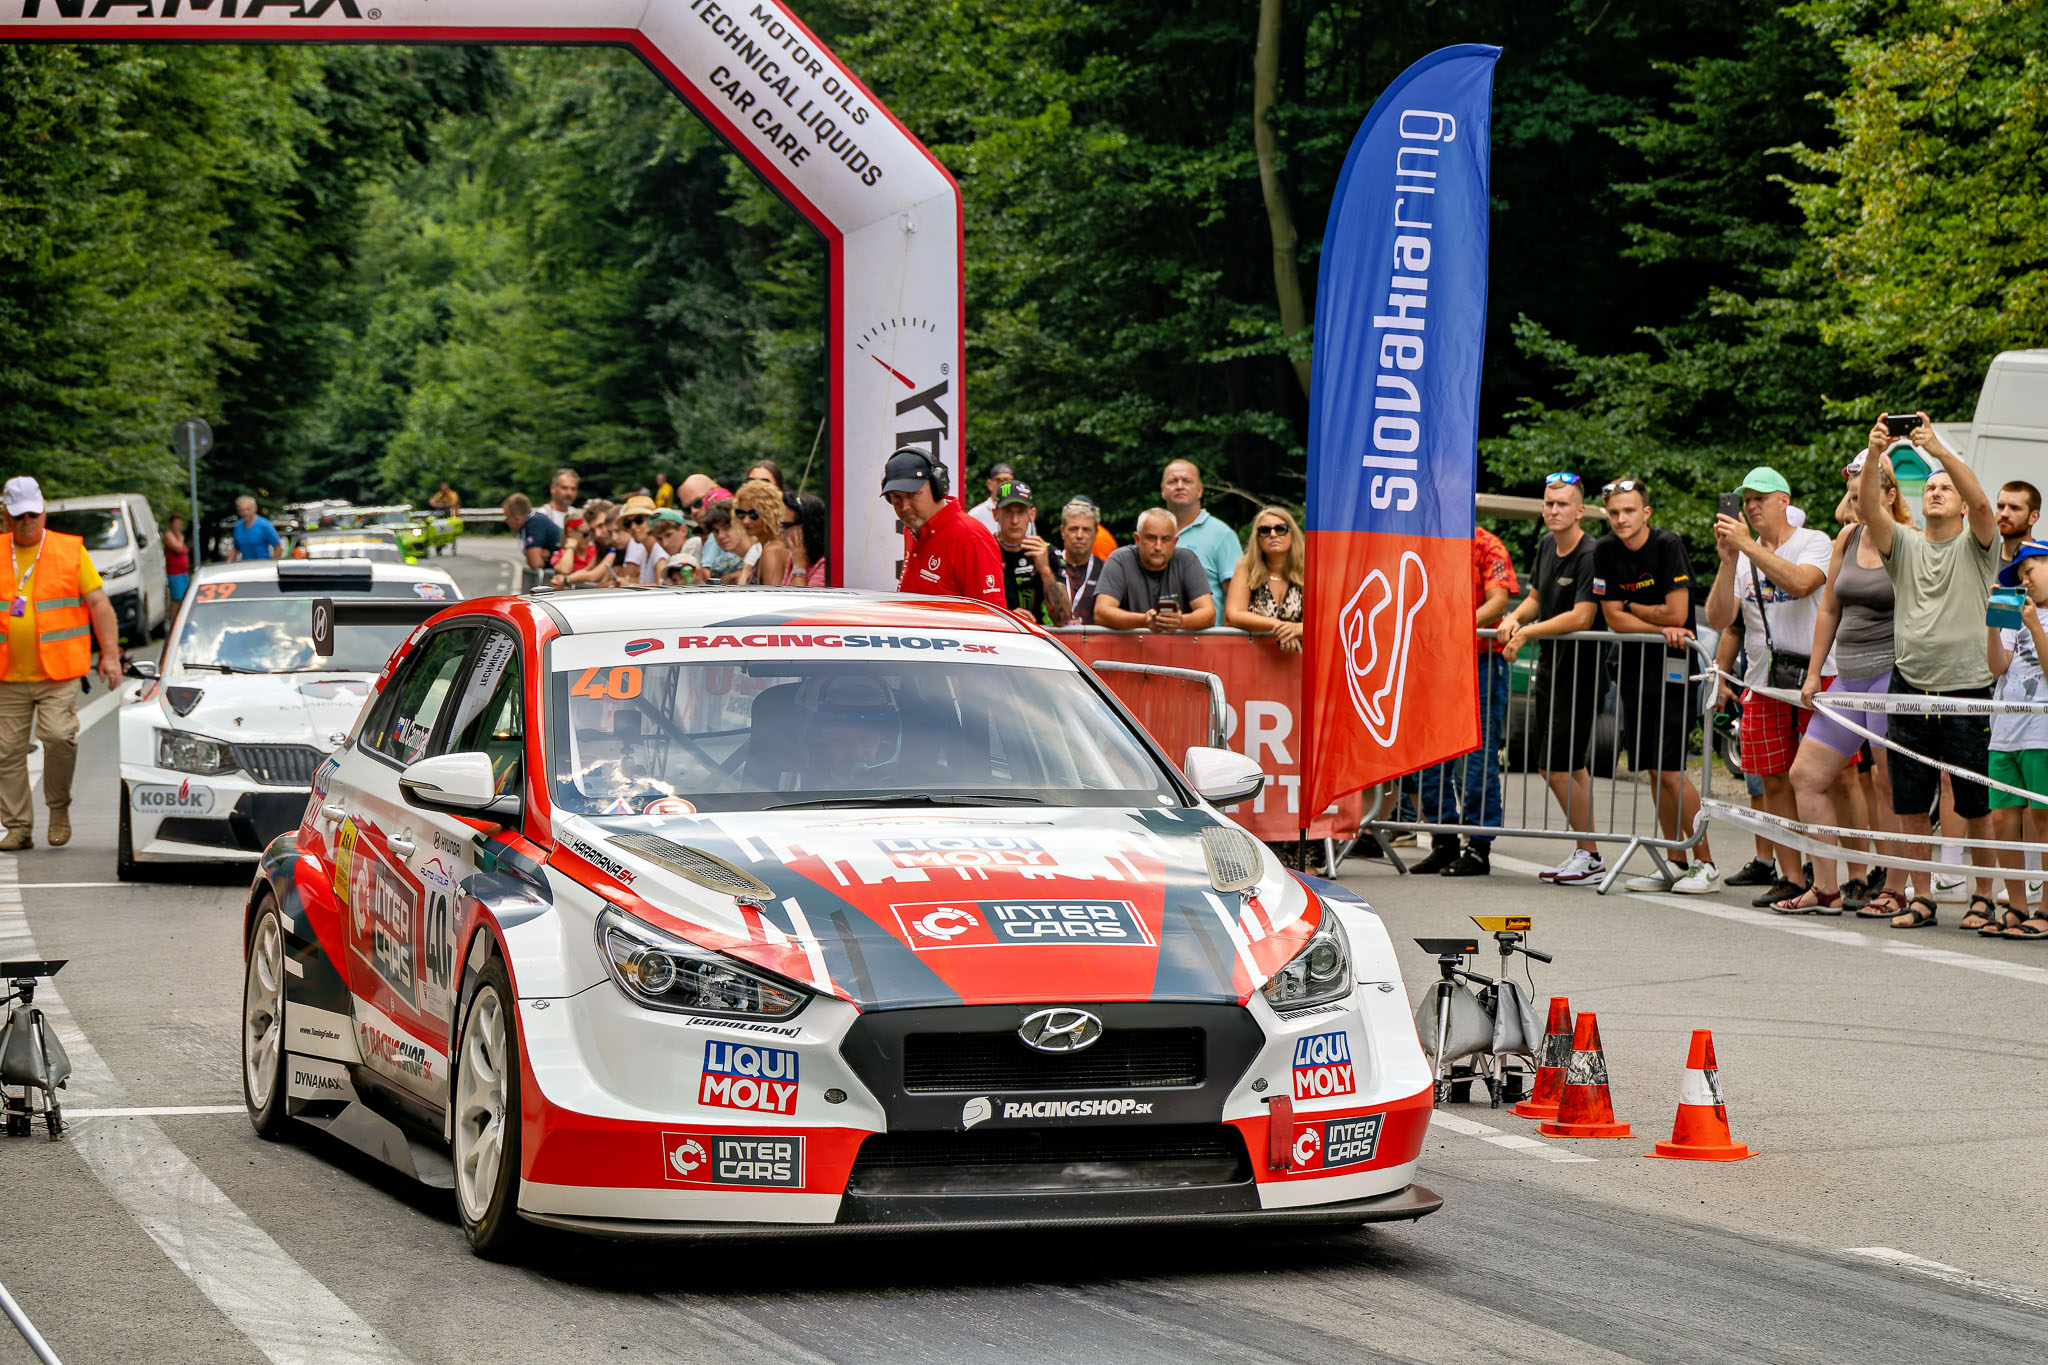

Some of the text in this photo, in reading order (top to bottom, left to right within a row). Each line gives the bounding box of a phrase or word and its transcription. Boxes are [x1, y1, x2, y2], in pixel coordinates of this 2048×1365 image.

[749, 4, 870, 126] MOTOR OILS
[690, 0, 883, 187] TECHNICAL LIQUIDS
[709, 65, 811, 168] CAR CARE
[196, 583, 237, 601] 39
[677, 634, 999, 655] RACINGSHOP.SK
[570, 666, 643, 700] 40
[1895, 702, 1922, 712] DYNAMAX
[140, 792, 203, 807] KOBOK
[440, 836, 462, 858] HYUNDAI
[881, 837, 1042, 852] LIQUI
[893, 851, 1046, 867] MOLY
[375, 873, 410, 944] INTER
[993, 904, 1117, 921] INTER
[425, 890, 448, 990] 40
[1003, 920, 1128, 938] CARS
[375, 919, 411, 989] CARS
[1295, 1034, 1349, 1066] LIQUI
[707, 1043, 795, 1080] LIQUI
[294, 1070, 345, 1090] DYNAMAX
[1295, 1065, 1353, 1098] MOLY
[703, 1075, 797, 1112] MOLY
[1003, 1098, 1154, 1119] RACINGSHOP.SK
[1328, 1120, 1377, 1143] INTER
[719, 1141, 792, 1161] INTER
[1327, 1138, 1373, 1162] CARS
[719, 1161, 792, 1181] CARS
